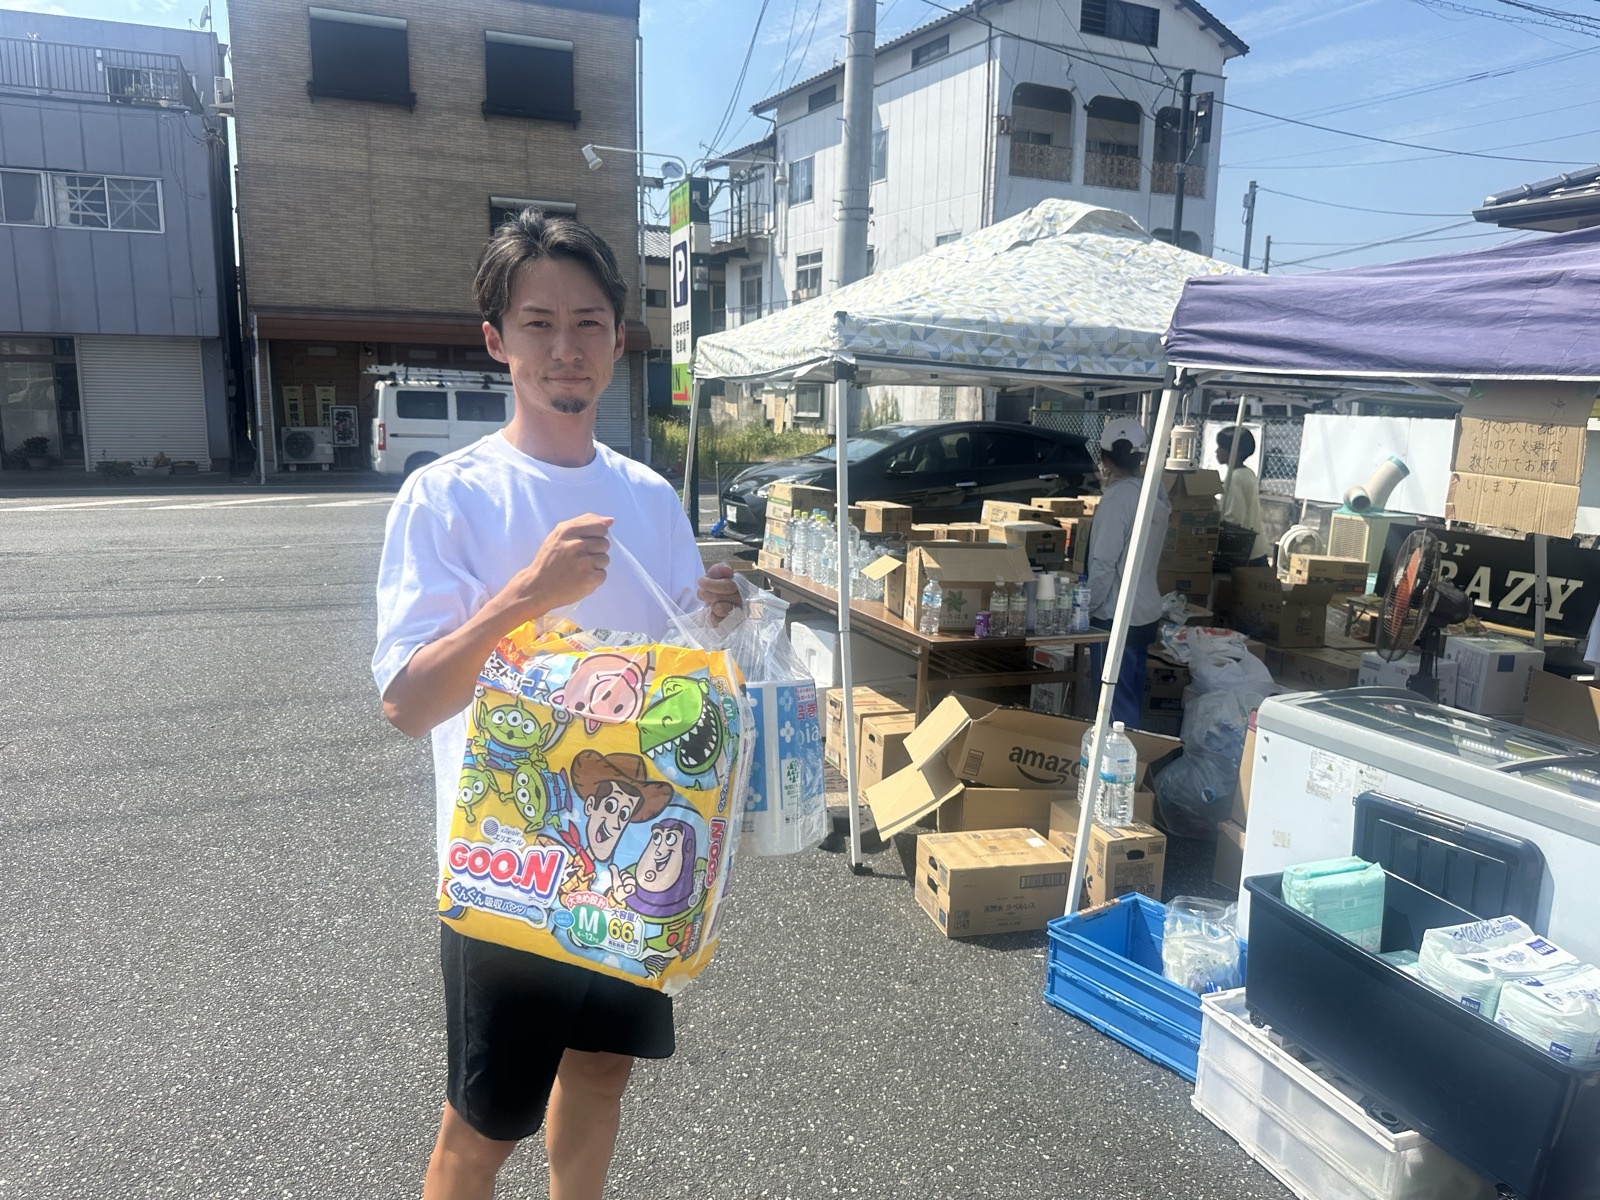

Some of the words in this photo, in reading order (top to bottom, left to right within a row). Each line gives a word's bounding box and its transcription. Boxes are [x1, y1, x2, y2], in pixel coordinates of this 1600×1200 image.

[676, 249, 685, 302] P
[673, 368, 681, 391] IN
[1471, 437, 1563, 457] たいので必要な
[1395, 557, 1584, 620] RAZY
[1008, 746, 1080, 778] amazo
[494, 834, 524, 846] エリエール
[579, 906, 599, 934] M
[983, 903, 1003, 914] 天然水
[1006, 902, 1036, 911] ラベルレス
